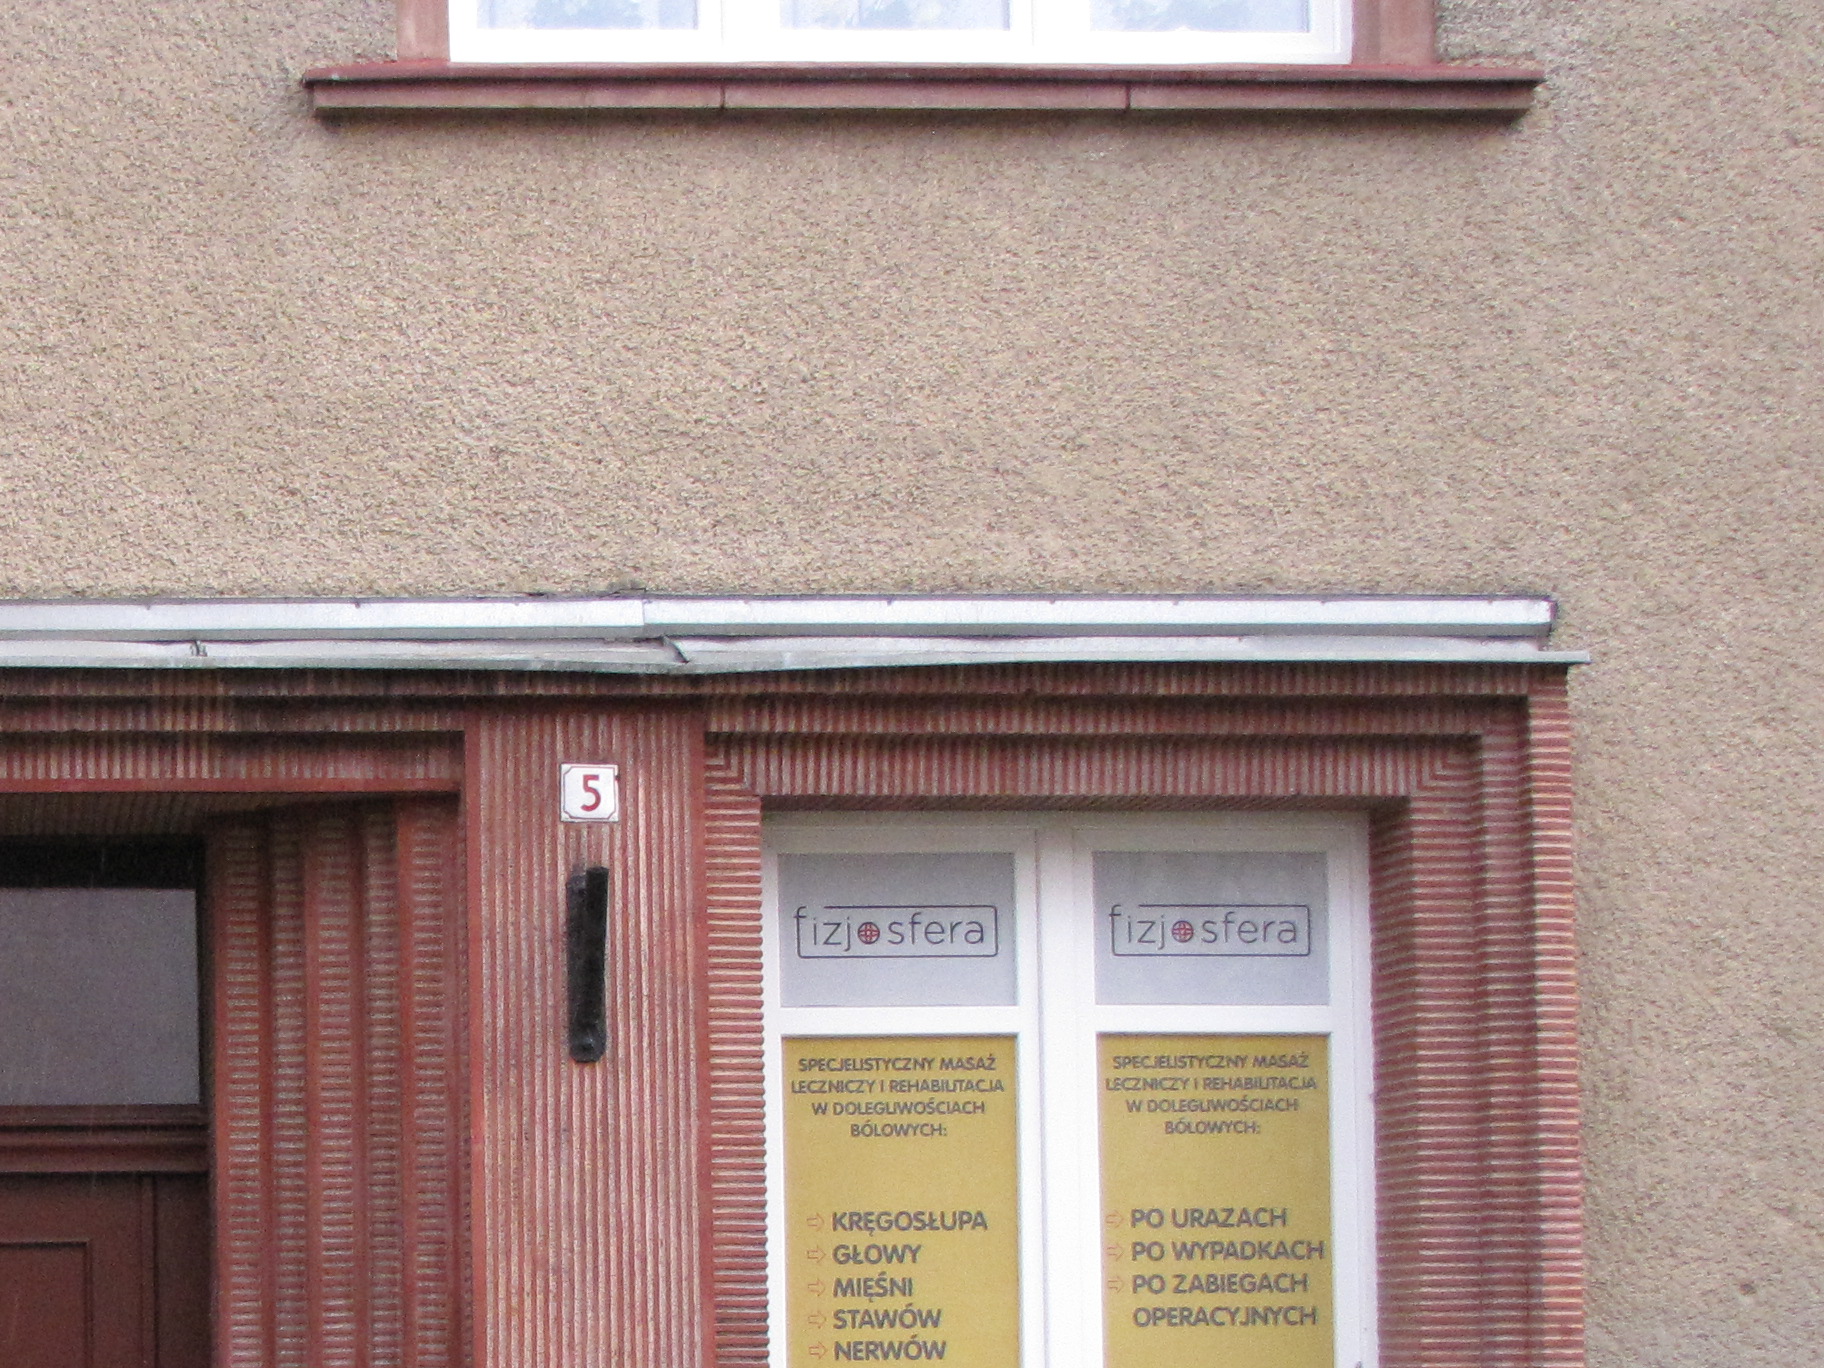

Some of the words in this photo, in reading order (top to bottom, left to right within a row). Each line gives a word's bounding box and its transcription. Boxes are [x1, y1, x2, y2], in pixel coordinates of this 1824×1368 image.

[580, 774, 602, 812] 5
[940, 1053, 997, 1071] MASAŻ
[1252, 1051, 1309, 1068] MASAŻ
[791, 1079, 875, 1094] LECZNICZY
[880, 1079, 884, 1093] I
[890, 1078, 1004, 1093] REHABILITACJA
[1105, 1077, 1190, 1091] LECZNICZY
[1193, 1077, 1198, 1091] I
[1203, 1076, 1318, 1091] REHABILITACJA
[811, 1102, 828, 1115] W
[833, 1097, 985, 1115] DOLEGLIWOŚCIACH
[1126, 1099, 1143, 1113] W
[1147, 1095, 1300, 1112] DOLEGLIWOŚCIACH
[850, 1119, 947, 1137] BÓLOWYCH:
[1164, 1117, 1260, 1135] BÓLOWYCH:
[832, 1210, 988, 1236] KRĘGOSŁUPA
[1130, 1208, 1164, 1229] PO
[1171, 1207, 1287, 1228] URAZACH
[832, 1243, 921, 1264] GŁOWY
[1131, 1241, 1165, 1261] PO
[1171, 1240, 1326, 1261] WYPADKACH
[833, 1271, 913, 1302] MIĘŚNI
[1132, 1274, 1166, 1294] PO
[1172, 1272, 1309, 1293] ZABIEGACH
[833, 1303, 942, 1329] STAWÓW
[1133, 1306, 1318, 1327] OPERACYJNYCH
[833, 1334, 947, 1361] NERWÓW
